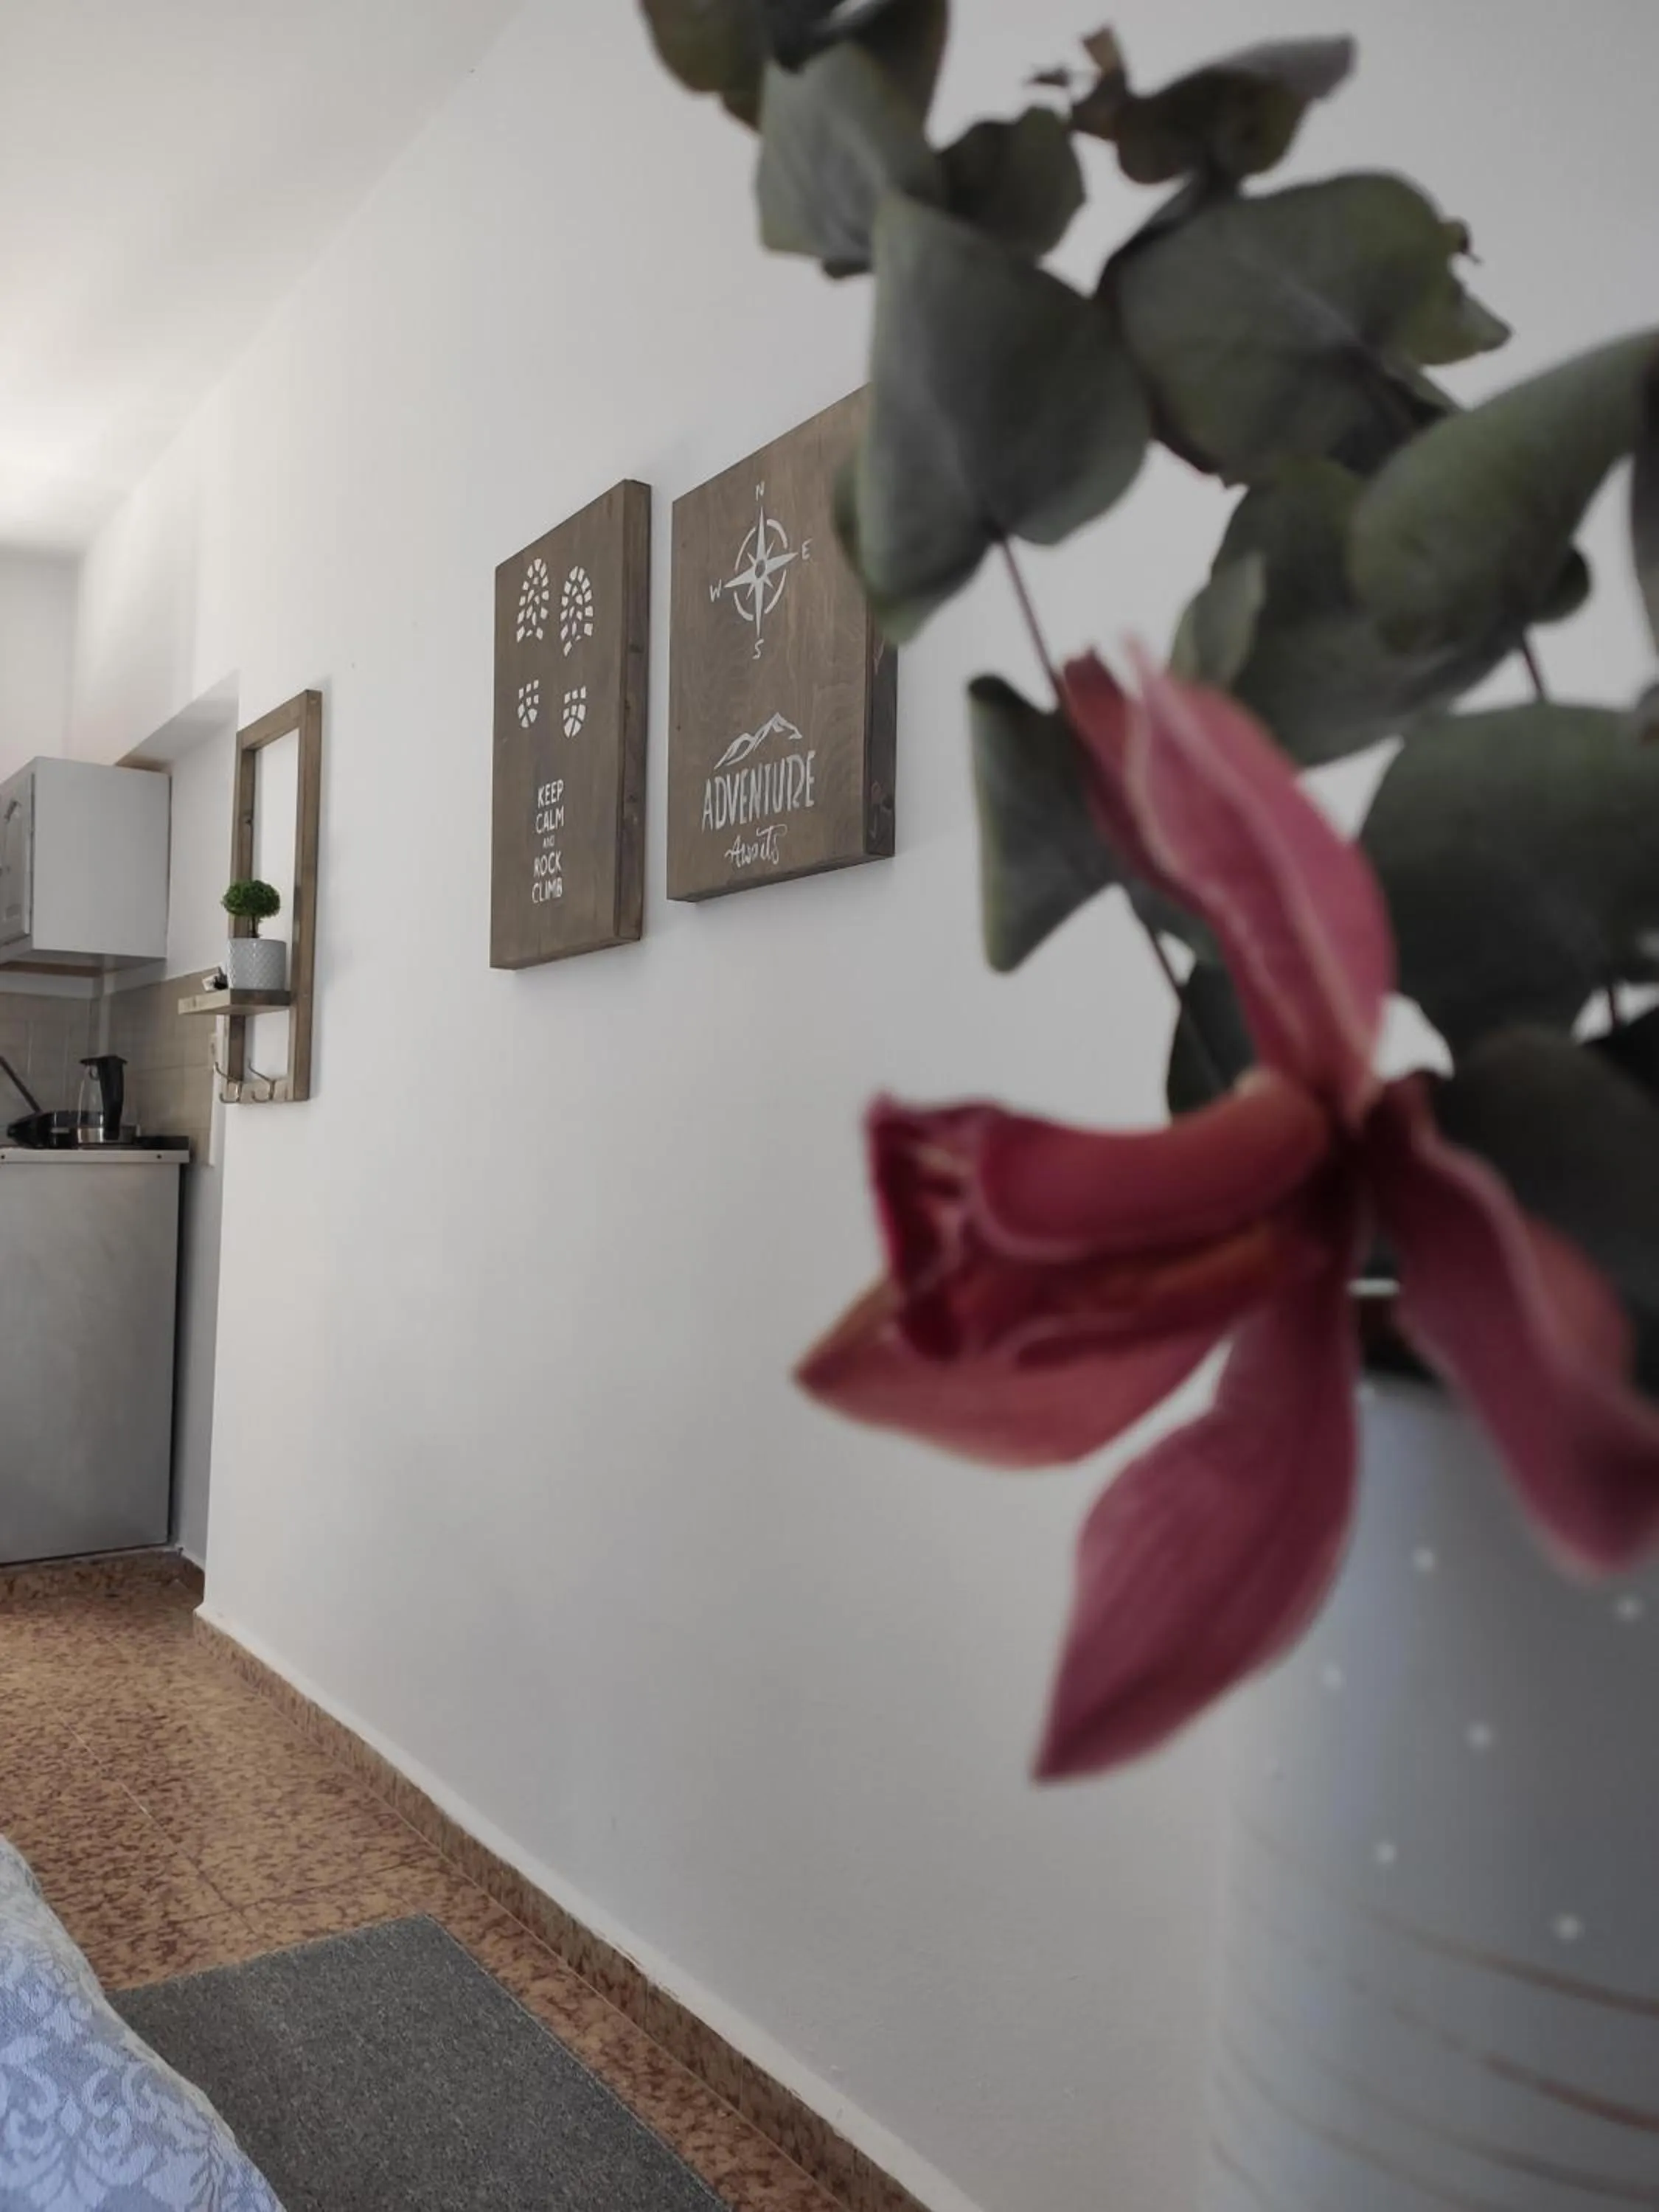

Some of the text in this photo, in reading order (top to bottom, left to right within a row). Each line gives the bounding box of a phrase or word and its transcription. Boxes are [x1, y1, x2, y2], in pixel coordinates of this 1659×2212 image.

[756, 481, 765, 501] N
[802, 538, 813, 560] E
[710, 579, 722, 602] W
[752, 639, 765, 659] S
[538, 779, 564, 808] KEEP
[701, 750, 816, 835] ADVENTURE
[535, 805, 564, 834] CALM
[533, 850, 561, 879] ROCK
[532, 877, 563, 903] CLIMB
